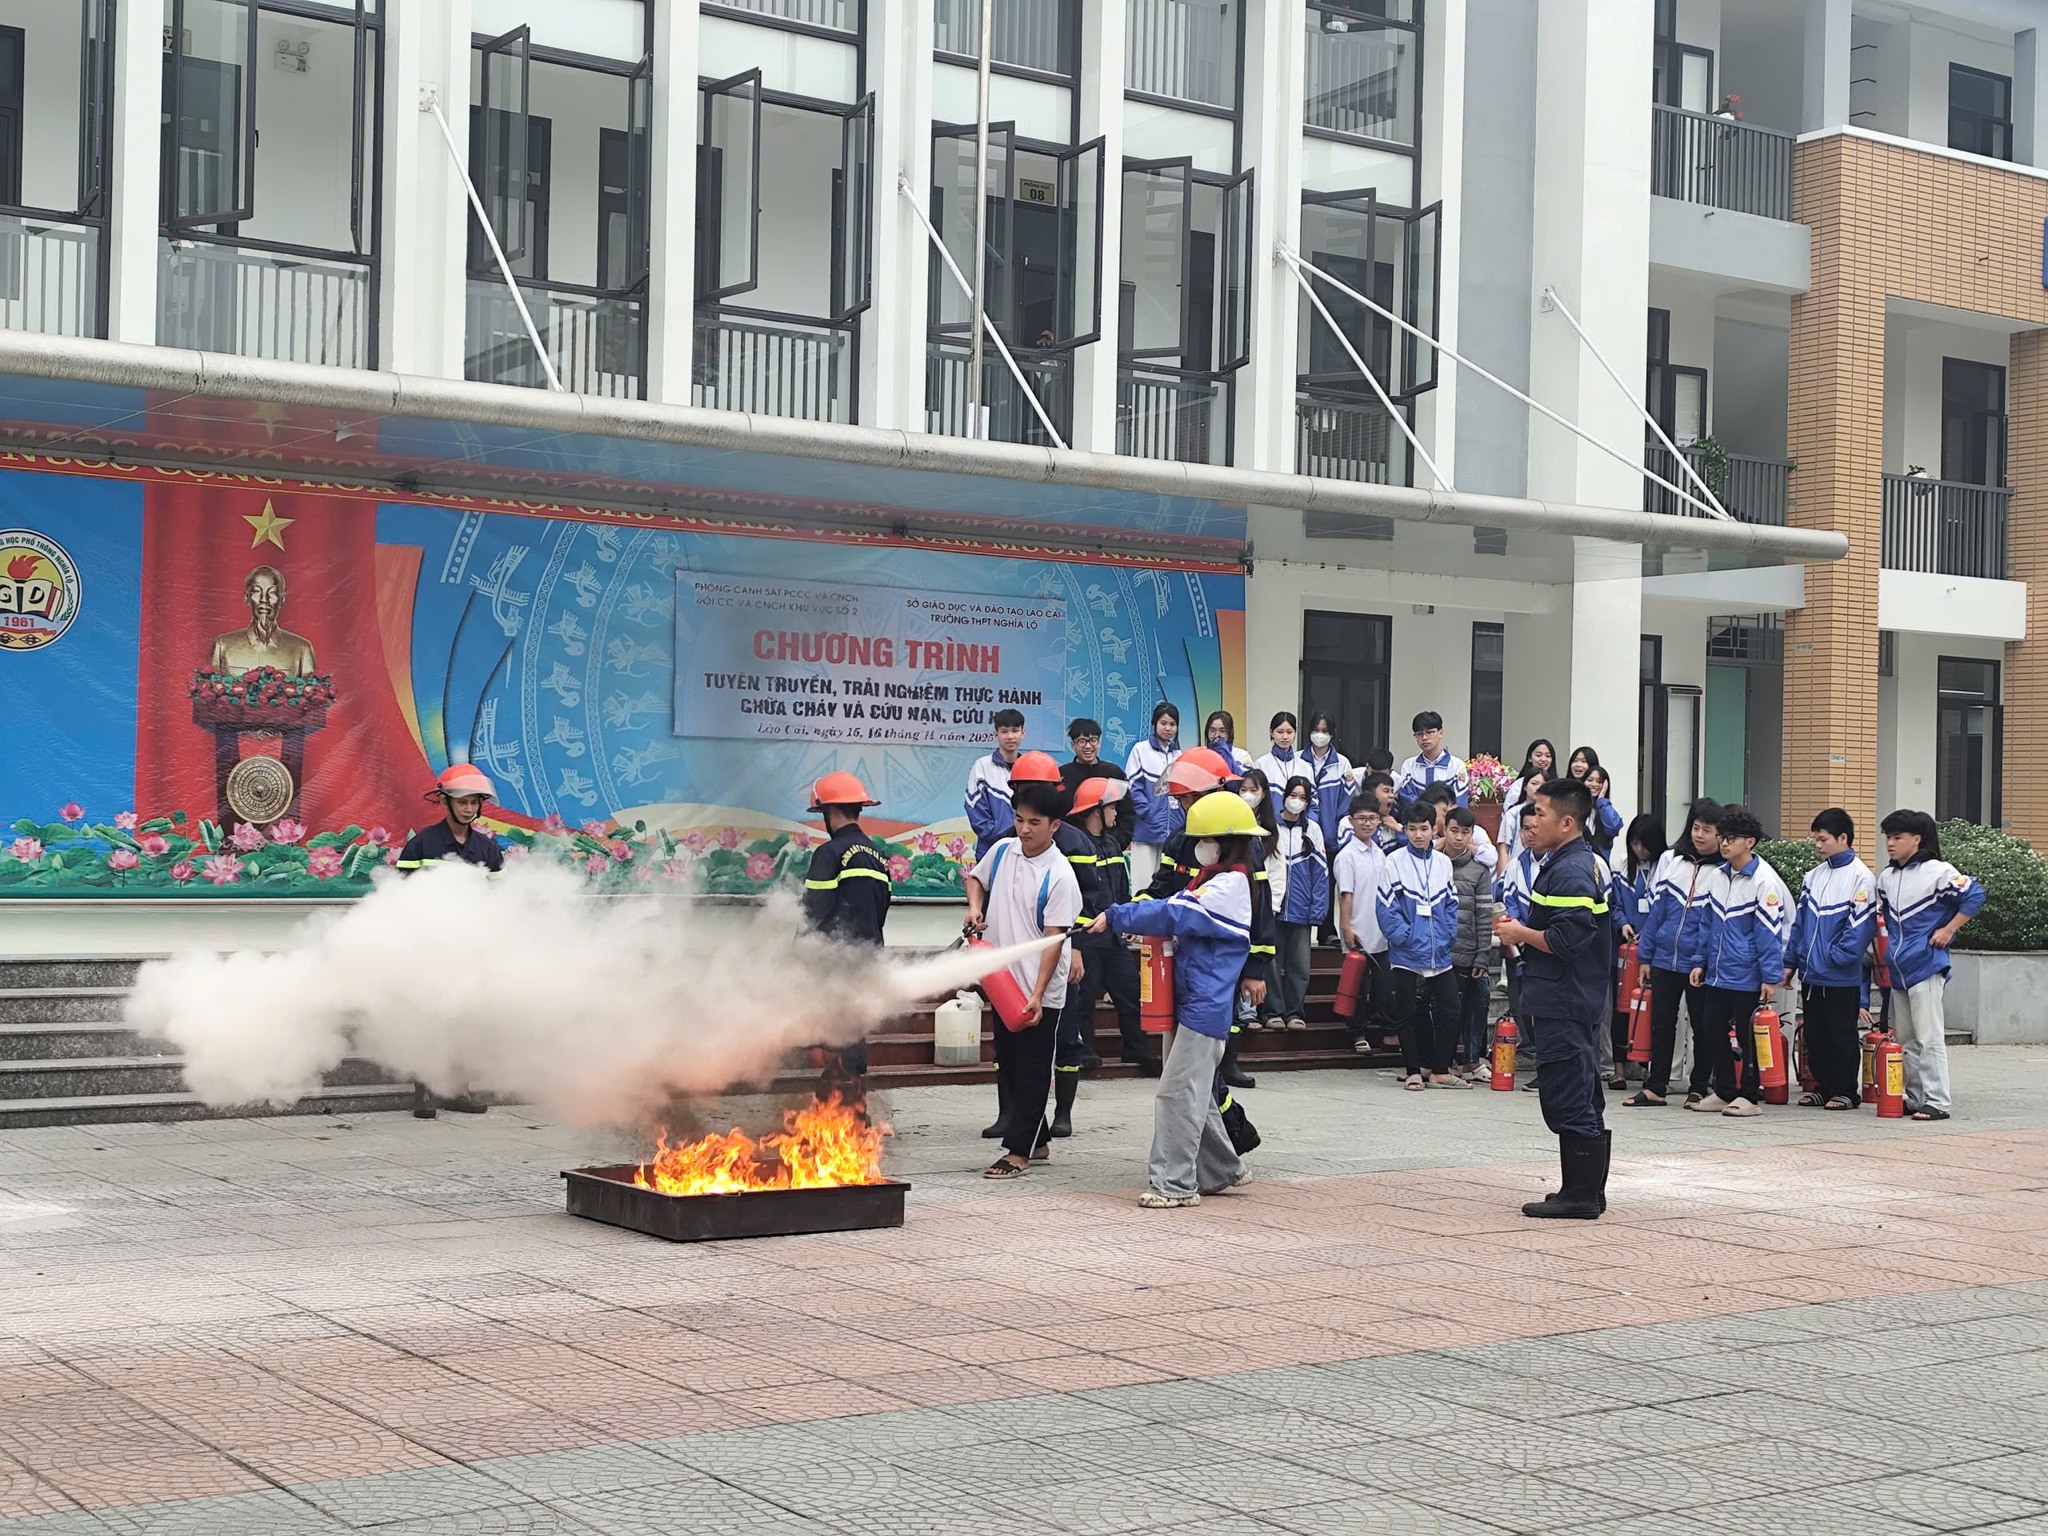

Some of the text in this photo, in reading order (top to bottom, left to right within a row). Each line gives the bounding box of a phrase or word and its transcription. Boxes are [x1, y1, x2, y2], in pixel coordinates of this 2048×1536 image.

[1029, 189, 1045, 200] 08
[5, 536, 20, 545] HỌC
[36, 540, 57, 557] THÔNG
[54, 555, 70, 575] NGHĨA
[783, 589, 811, 599] PCCC
[830, 592, 859, 602] CNCH
[755, 600, 786, 610] CNCH
[852, 607, 858, 616] 2
[906, 597, 1061, 618] SỞ GIÁO DỤC VÀ ĐÀO TẠO LÀO CAI
[3, 616, 35, 628] 1961
[930, 613, 1039, 631] TRƯỜNG THPT NGHĨA LỘ
[753, 629, 1000, 673] CHƯƠNG TRÌNH
[704, 671, 760, 691] TUYÊN
[842, 677, 880, 697] TRẢI
[884, 682, 949, 704] NGHIỆM
[954, 686, 994, 706] THỰC
[998, 685, 1042, 706] HÀNH
[740, 695, 787, 716] CHỮA
[792, 698, 838, 718] CHÁY
[843, 700, 865, 719] VÀ
[869, 702, 903, 721] CỨU
[952, 706, 984, 724] CỨU
[988, 710, 997, 725] H
[757, 722, 781, 734] Lào
[813, 725, 844, 739] ngày
[846, 727, 864, 739] 15,
[884, 727, 921, 742] tháng
[924, 730, 935, 741] 11
[939, 731, 965, 742] năm
[968, 731, 994, 743] 2025
